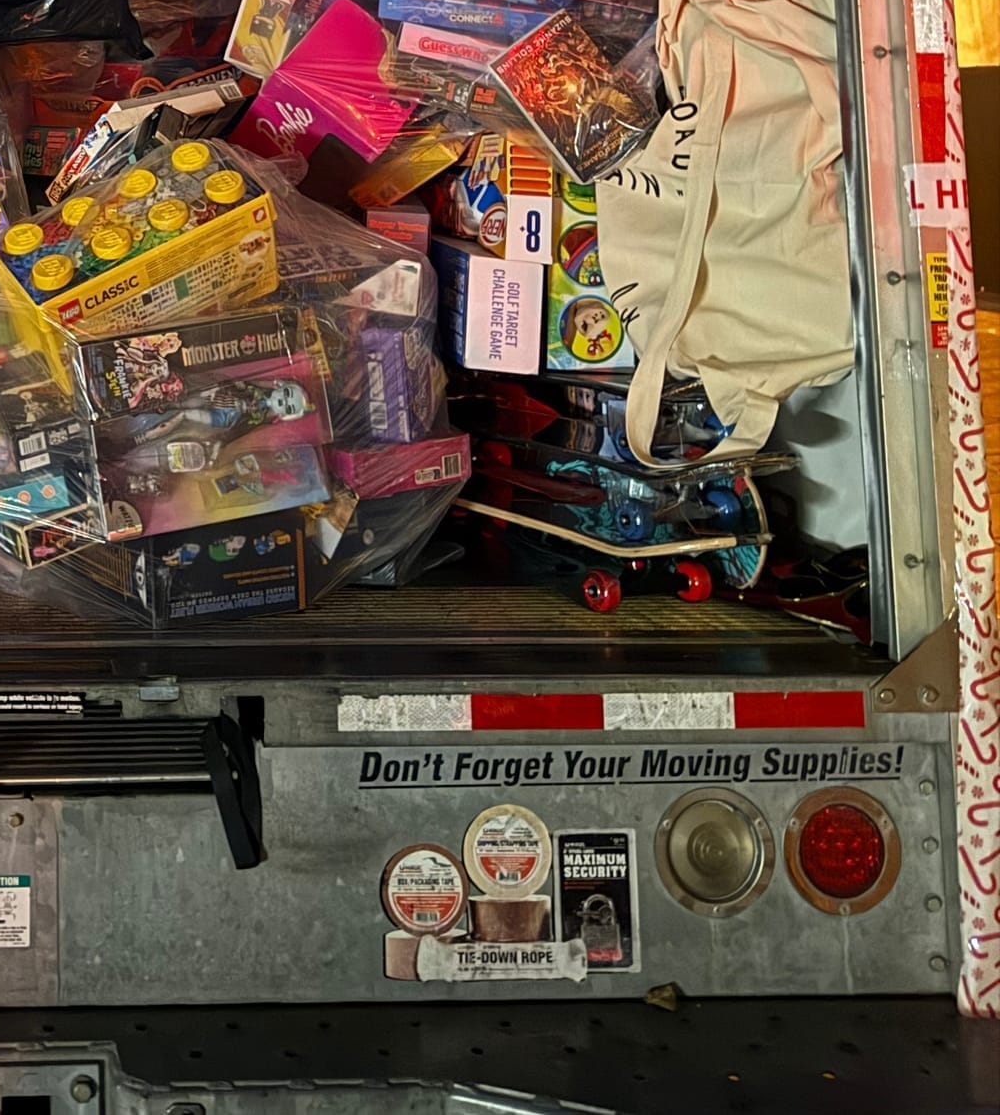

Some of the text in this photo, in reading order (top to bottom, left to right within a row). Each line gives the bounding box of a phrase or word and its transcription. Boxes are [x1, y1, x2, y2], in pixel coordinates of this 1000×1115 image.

[449, 13, 494, 25] CONNECT
[256, 100, 314, 157] Barbie
[84, 275, 140, 310] CLASSIC
[489, 268, 506, 361] CHALLENGE GAME
[505, 282, 521, 348] GOLF TARGET
[182, 333, 285, 367] MONSTER HIGH
[113, 355, 133, 398] FRANKIE
[360, 745, 904, 786] Don't Forget Your Moving Supplies!
[563, 866, 627, 878] SECURITY
[564, 853, 626, 866] MAXIMUM
[457, 950, 553, 965] TIE-DOWN ROPE
